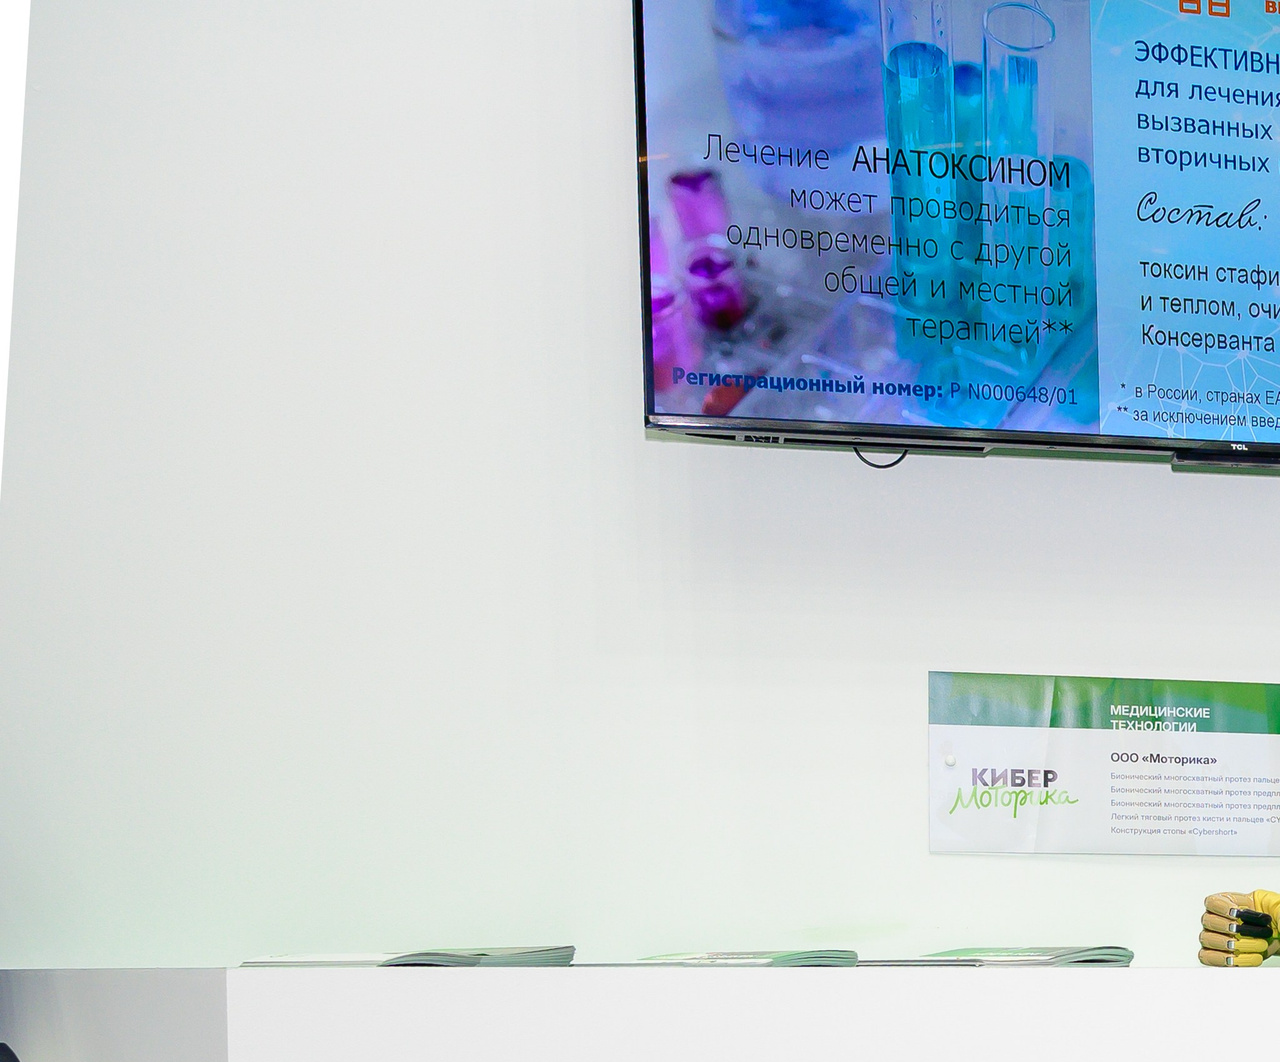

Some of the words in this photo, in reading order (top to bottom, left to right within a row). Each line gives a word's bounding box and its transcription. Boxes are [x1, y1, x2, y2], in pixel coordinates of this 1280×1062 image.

[1135, 79, 1179, 99] для
[1137, 113, 1273, 140] вызванных
[703, 134, 829, 170] Лечение
[852, 145, 1070, 189] АНАТОКСИНОМ
[1138, 146, 1270, 173] вторичных
[790, 188, 877, 214] может
[891, 196, 1070, 228] проводиться
[1137, 191, 1268, 230] Состав:
[726, 224, 939, 259] одновременно
[950, 243, 964, 260] с
[975, 242, 1071, 270] другой
[1140, 260, 1208, 282] токсин
[825, 266, 918, 299] общей
[931, 280, 946, 298] и
[959, 278, 1073, 307] местной
[1141, 295, 1152, 312] и
[1160, 296, 1241, 320] теплом,
[1142, 324, 1275, 353] Консерванта
[672, 367, 866, 395] Регистрационный
[872, 379, 943, 400] номер:
[969, 385, 1078, 406] N000648/01
[1135, 386, 1142, 398] в
[1148, 384, 1201, 403] России,
[1207, 389, 1261, 405] странах
[1133, 409, 1148, 421] за
[1153, 411, 1246, 427] исключением
[1110, 705, 1210, 718] МЕДИЦИНСКИЕ
[1111, 720, 1196, 732] ТЕХНОЛОГИИ
[1111, 753, 1139, 763] ООО
[1142, 753, 1217, 766] «Моторика»
[971, 768, 1058, 788] КИБЕР
[1111, 772, 1162, 781] Бионический
[1164, 775, 1223, 783] многосхватный
[1111, 786, 1162, 795] Бионический
[1164, 788, 1223, 796] многосхватный
[1225, 790, 1251, 798] протез
[1111, 800, 1162, 808] Бионический
[1164, 802, 1223, 810] многосхватный
[1111, 813, 1139, 821] Легкий
[1141, 814, 1172, 822] тяговый
[1111, 827, 1160, 835] Конструкция
[1188, 828, 1237, 836] «Cybershort»
